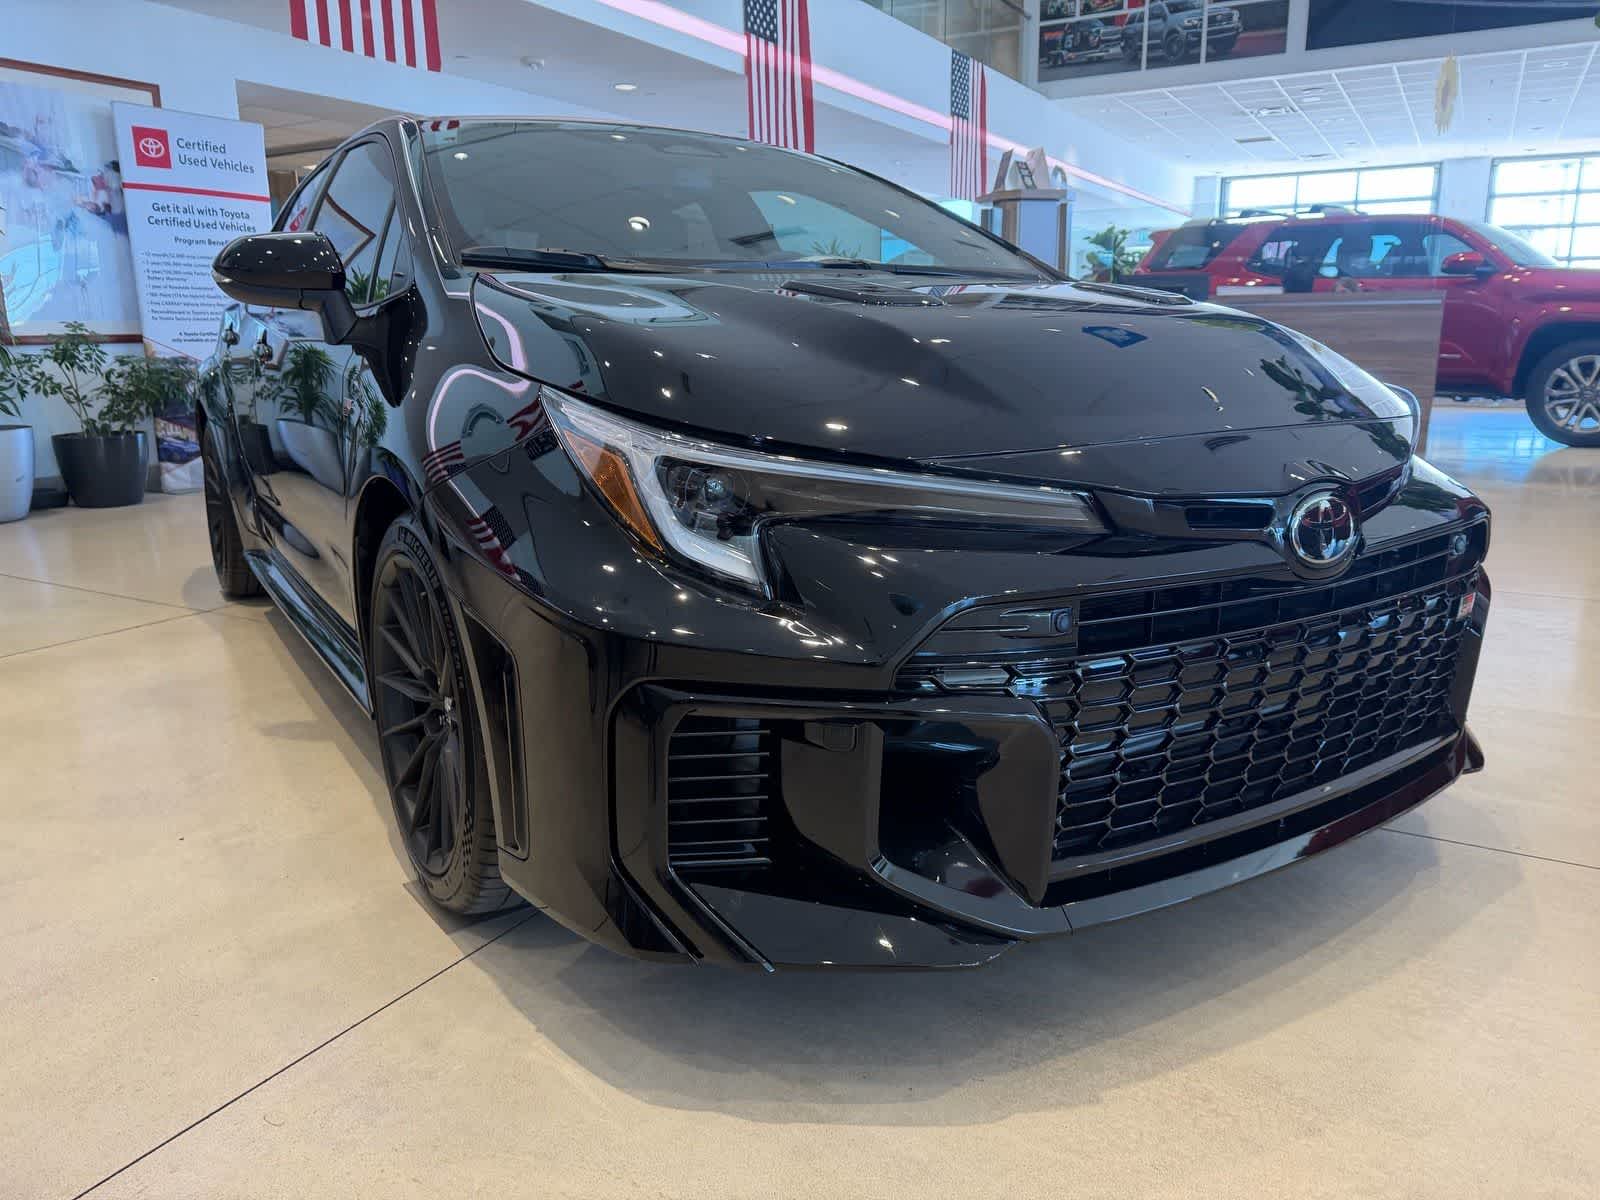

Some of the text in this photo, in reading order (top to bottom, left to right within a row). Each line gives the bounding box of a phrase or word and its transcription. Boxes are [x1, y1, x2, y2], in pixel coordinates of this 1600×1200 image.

[176, 137, 226, 154] Certified
[178, 153, 255, 174] Used Vehicles
[152, 202, 250, 220] Get it all with Toyota
[147, 215, 256, 233] Certified Used Vehicles
[174, 235, 229, 246] Program Benef
